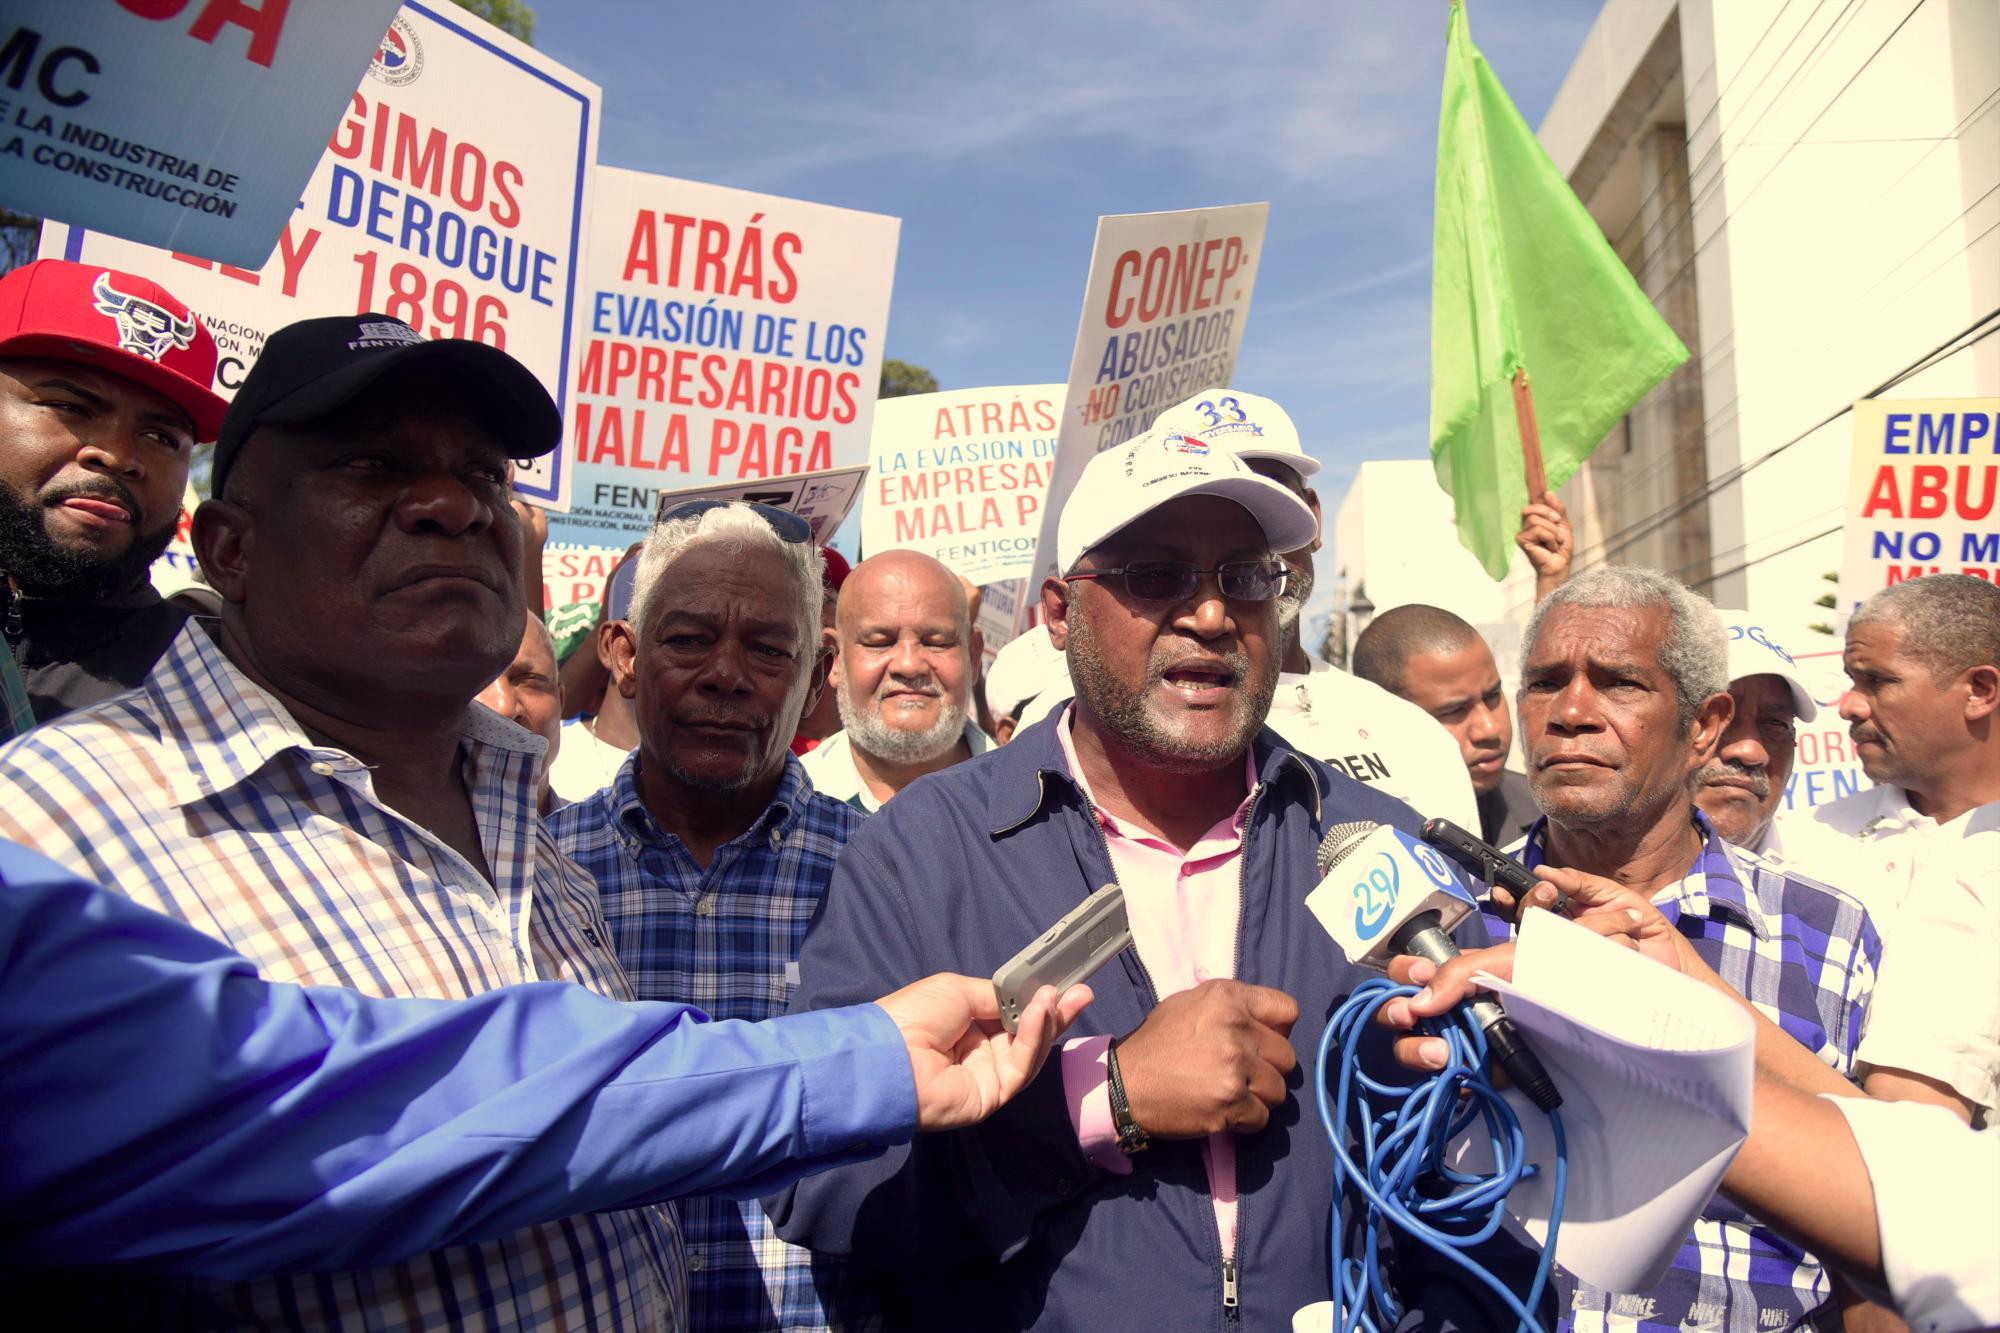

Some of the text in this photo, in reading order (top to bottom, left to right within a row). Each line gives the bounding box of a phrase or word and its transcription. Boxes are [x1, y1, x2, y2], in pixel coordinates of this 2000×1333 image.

[113, 0, 292, 69] A
[15, 106, 53, 137] LA
[60, 121, 199, 182] INDUSTRIA
[204, 168, 240, 193] DE
[33, 144, 238, 220] CONSTRUCCIÓN
[327, 163, 557, 307] DEROGUE
[622, 209, 803, 305] ATRÁS
[353, 250, 509, 353] 1896
[1104, 236, 1249, 329] CONEP:
[592, 290, 867, 367] EVASIÓN DE LOS
[1095, 308, 1235, 384] ABUSADOR
[934, 394, 1056, 440] ATRÁS
[1083, 383, 1121, 426] NO
[1195, 396, 1247, 427] 33
[708, 418, 833, 479] PAGA
[879, 452, 907, 474] LA
[895, 496, 1004, 543] MALA
[1872, 531, 1941, 561] NO
[1353, 868, 1396, 916] 29
[1618, 1294, 1658, 1317] NIKE
[1688, 1302, 1727, 1323] NIKE
